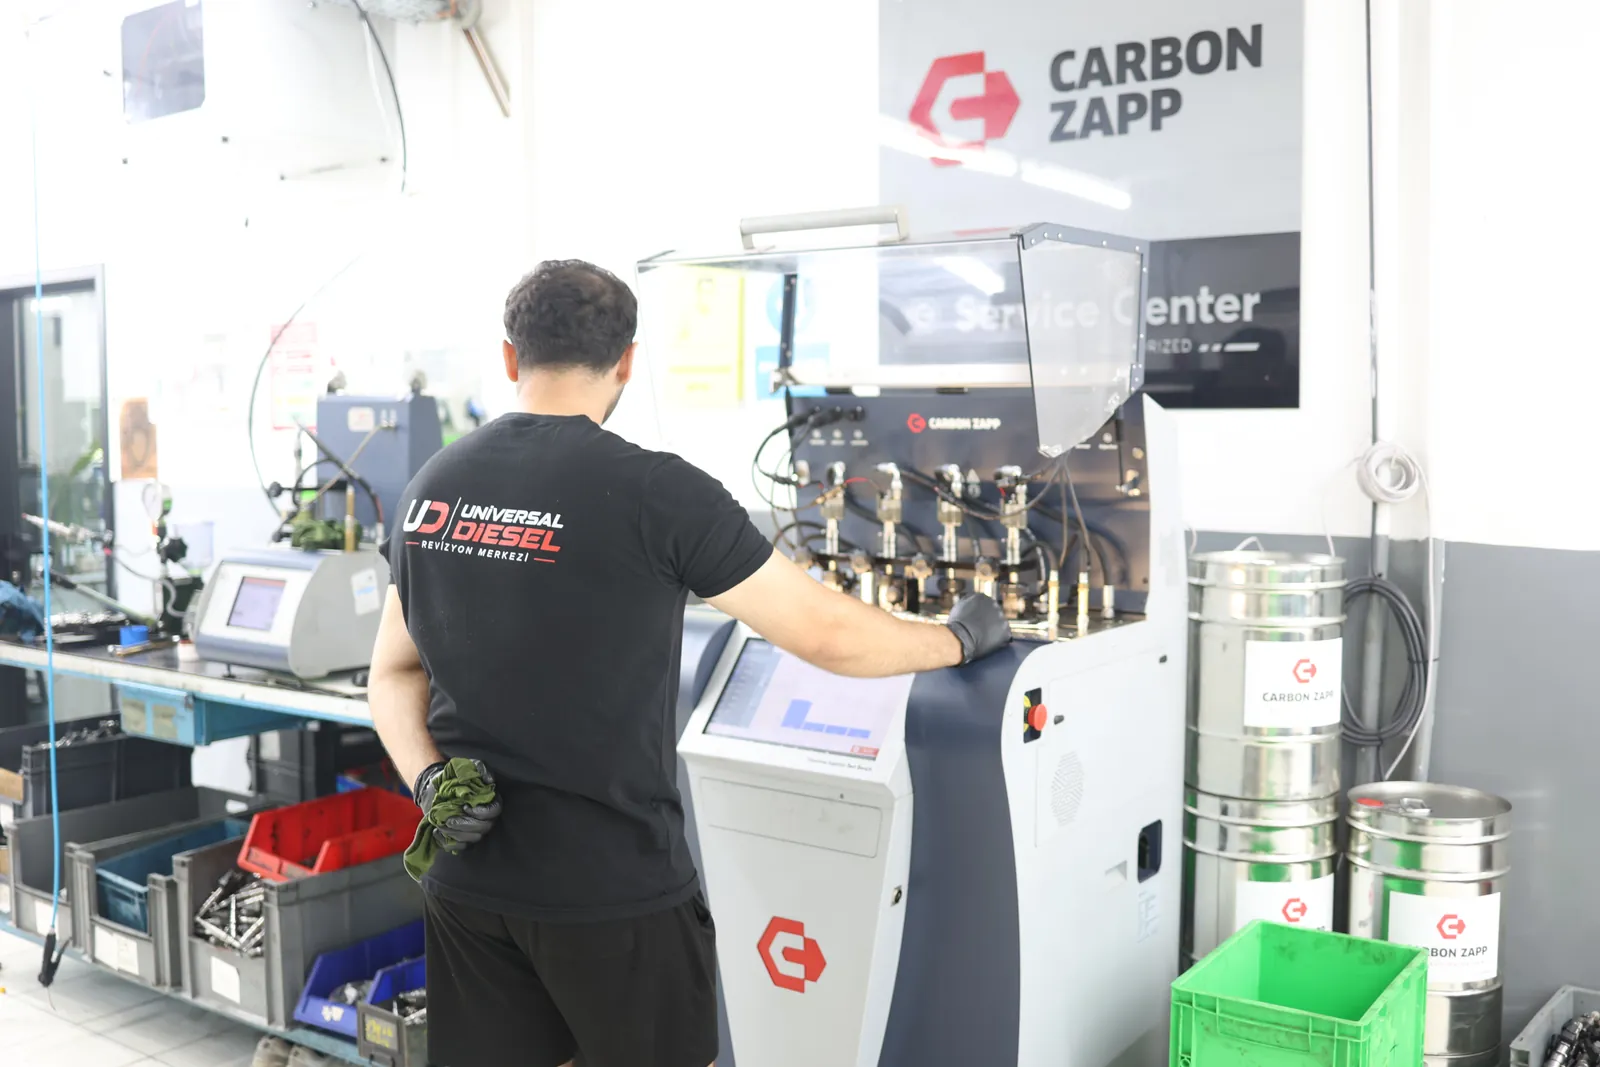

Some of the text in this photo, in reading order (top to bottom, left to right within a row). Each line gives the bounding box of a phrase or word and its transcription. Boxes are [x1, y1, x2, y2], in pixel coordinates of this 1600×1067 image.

[1049, 24, 1262, 92] CARBON
[1049, 88, 1183, 143] ZAPP
[954, 289, 1100, 333] Service
[1112, 286, 1261, 328] Center
[1146, 338, 1193, 354] RIZED
[1262, 692, 1310, 702] CARBON
[1460, 945, 1488, 957] ZAPP
